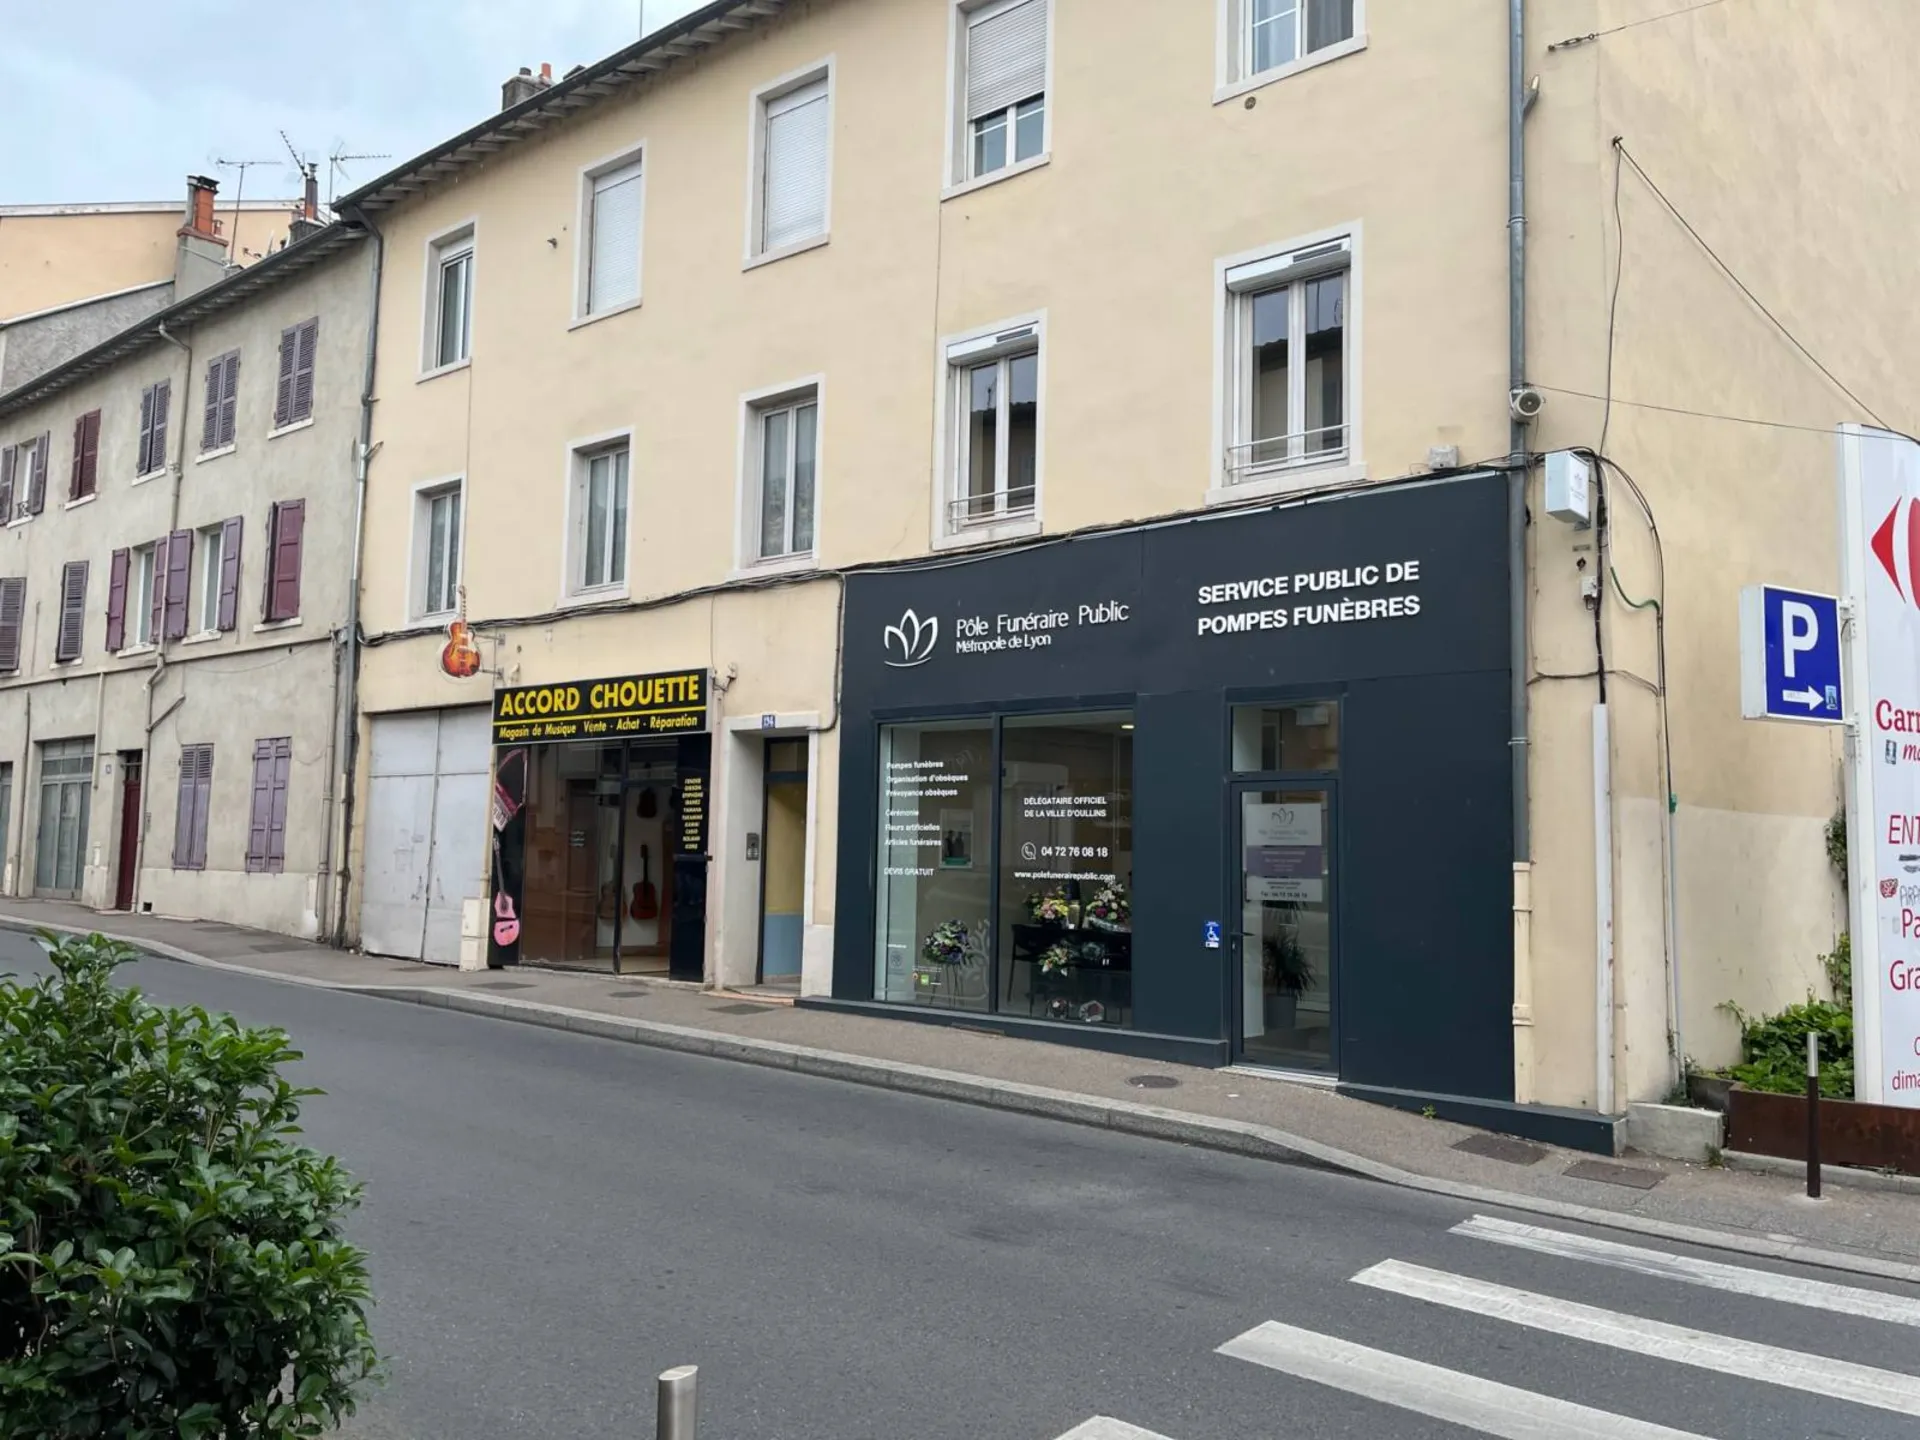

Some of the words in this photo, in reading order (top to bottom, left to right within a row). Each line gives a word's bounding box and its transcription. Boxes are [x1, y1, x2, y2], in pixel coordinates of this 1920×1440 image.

[1198, 576, 1288, 604] SERVICE
[1294, 565, 1379, 593] PUBLIC
[1385, 560, 1420, 583] DE
[956, 616, 989, 638] Pôle
[997, 610, 1069, 634] Funéraire
[1078, 600, 1129, 625] Public
[1198, 609, 1288, 635] POMPES
[1293, 595, 1420, 626] FUNÈBRES
[956, 636, 1007, 654] Métropole
[1008, 635, 1022, 649] de
[1024, 633, 1051, 650] Lyon
[1782, 600, 1818, 678] P
[500, 687, 580, 716] ACCORD
[590, 674, 699, 709] CHOUETTE
[499, 724, 529, 741] Magasin
[532, 723, 542, 736] de
[545, 722, 576, 737] Musique
[584, 720, 607, 733] Vente
[617, 717, 640, 730] Achat
[650, 714, 697, 731] Réparation
[886, 761, 912, 770] Pompes
[913, 760, 944, 769] funèbres
[886, 774, 928, 784] Organisation
[924, 787, 958, 797] obsèques
[1024, 796, 1072, 805] DÉLÉGATAIRE
[1074, 796, 1107, 805] OFFICIEL
[1046, 809, 1066, 817] VILLE
[1067, 809, 1106, 817] D'OULLINS
[884, 823, 904, 831] Fleurs
[1041, 847, 1052, 856] 04
[1055, 847, 1066, 856] 72
[1068, 847, 1080, 856] 76
[1081, 847, 1094, 857] 08
[1096, 847, 1108, 857] 18
[884, 867, 903, 875] DEVIS
[904, 867, 934, 876] GRATUIT
[1014, 870, 1116, 881] www.polefunerairepublic.com
[1892, 1070, 1920, 1091] dim
